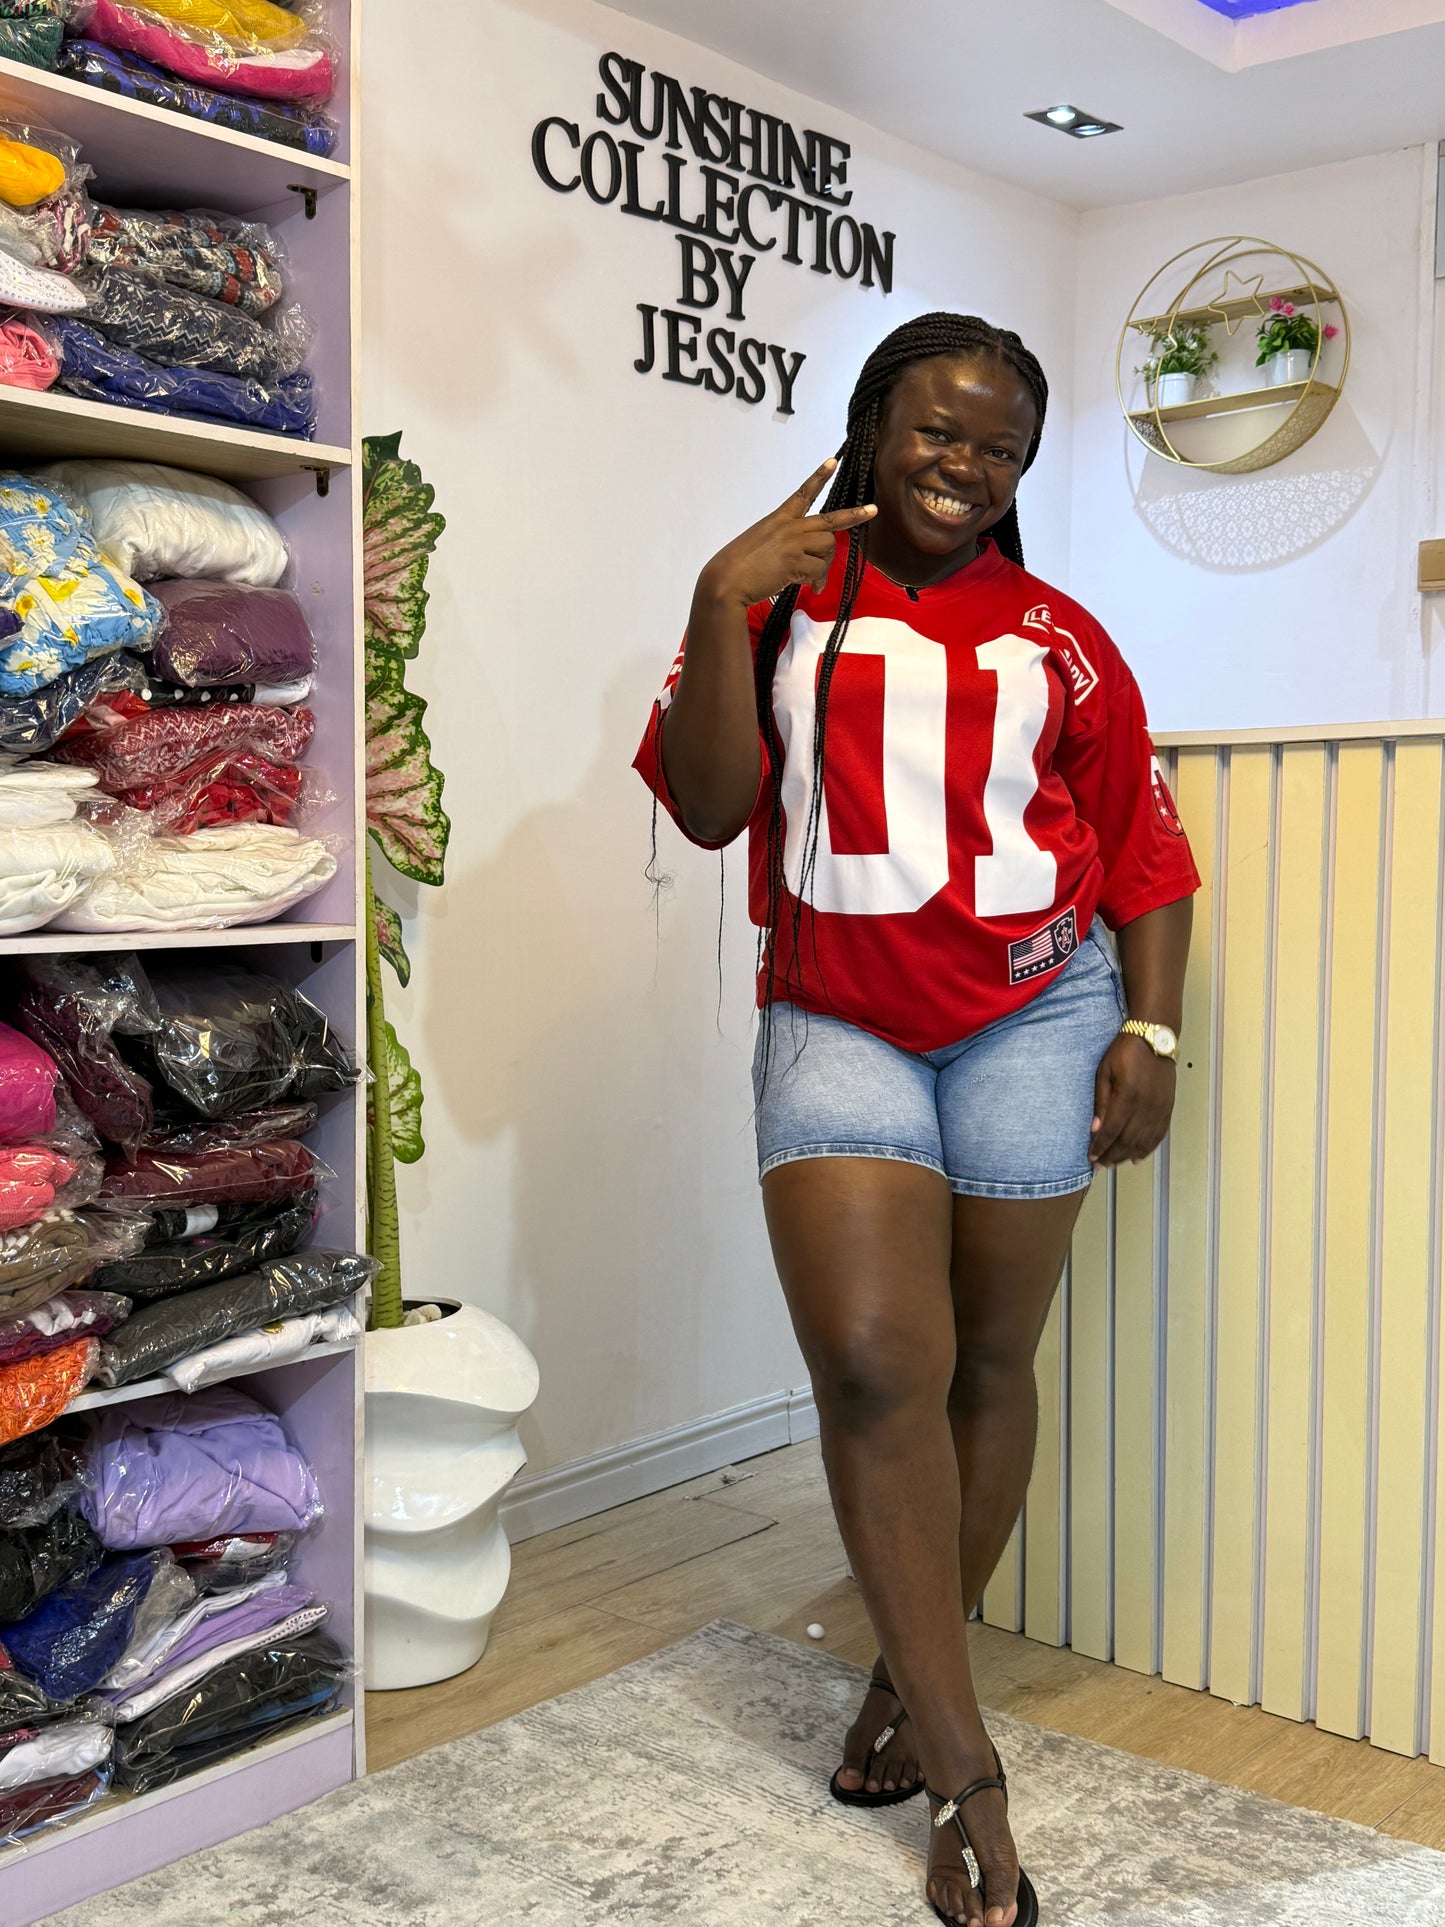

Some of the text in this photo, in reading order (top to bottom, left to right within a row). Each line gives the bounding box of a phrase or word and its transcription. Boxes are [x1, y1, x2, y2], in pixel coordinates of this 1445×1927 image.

[532, 117, 896, 294] COLLECTION
[597, 52, 853, 207] SUNSHINE
[675, 234, 756, 321] BY
[634, 304, 807, 415] JESSY
[772, 609, 1057, 917] 01
